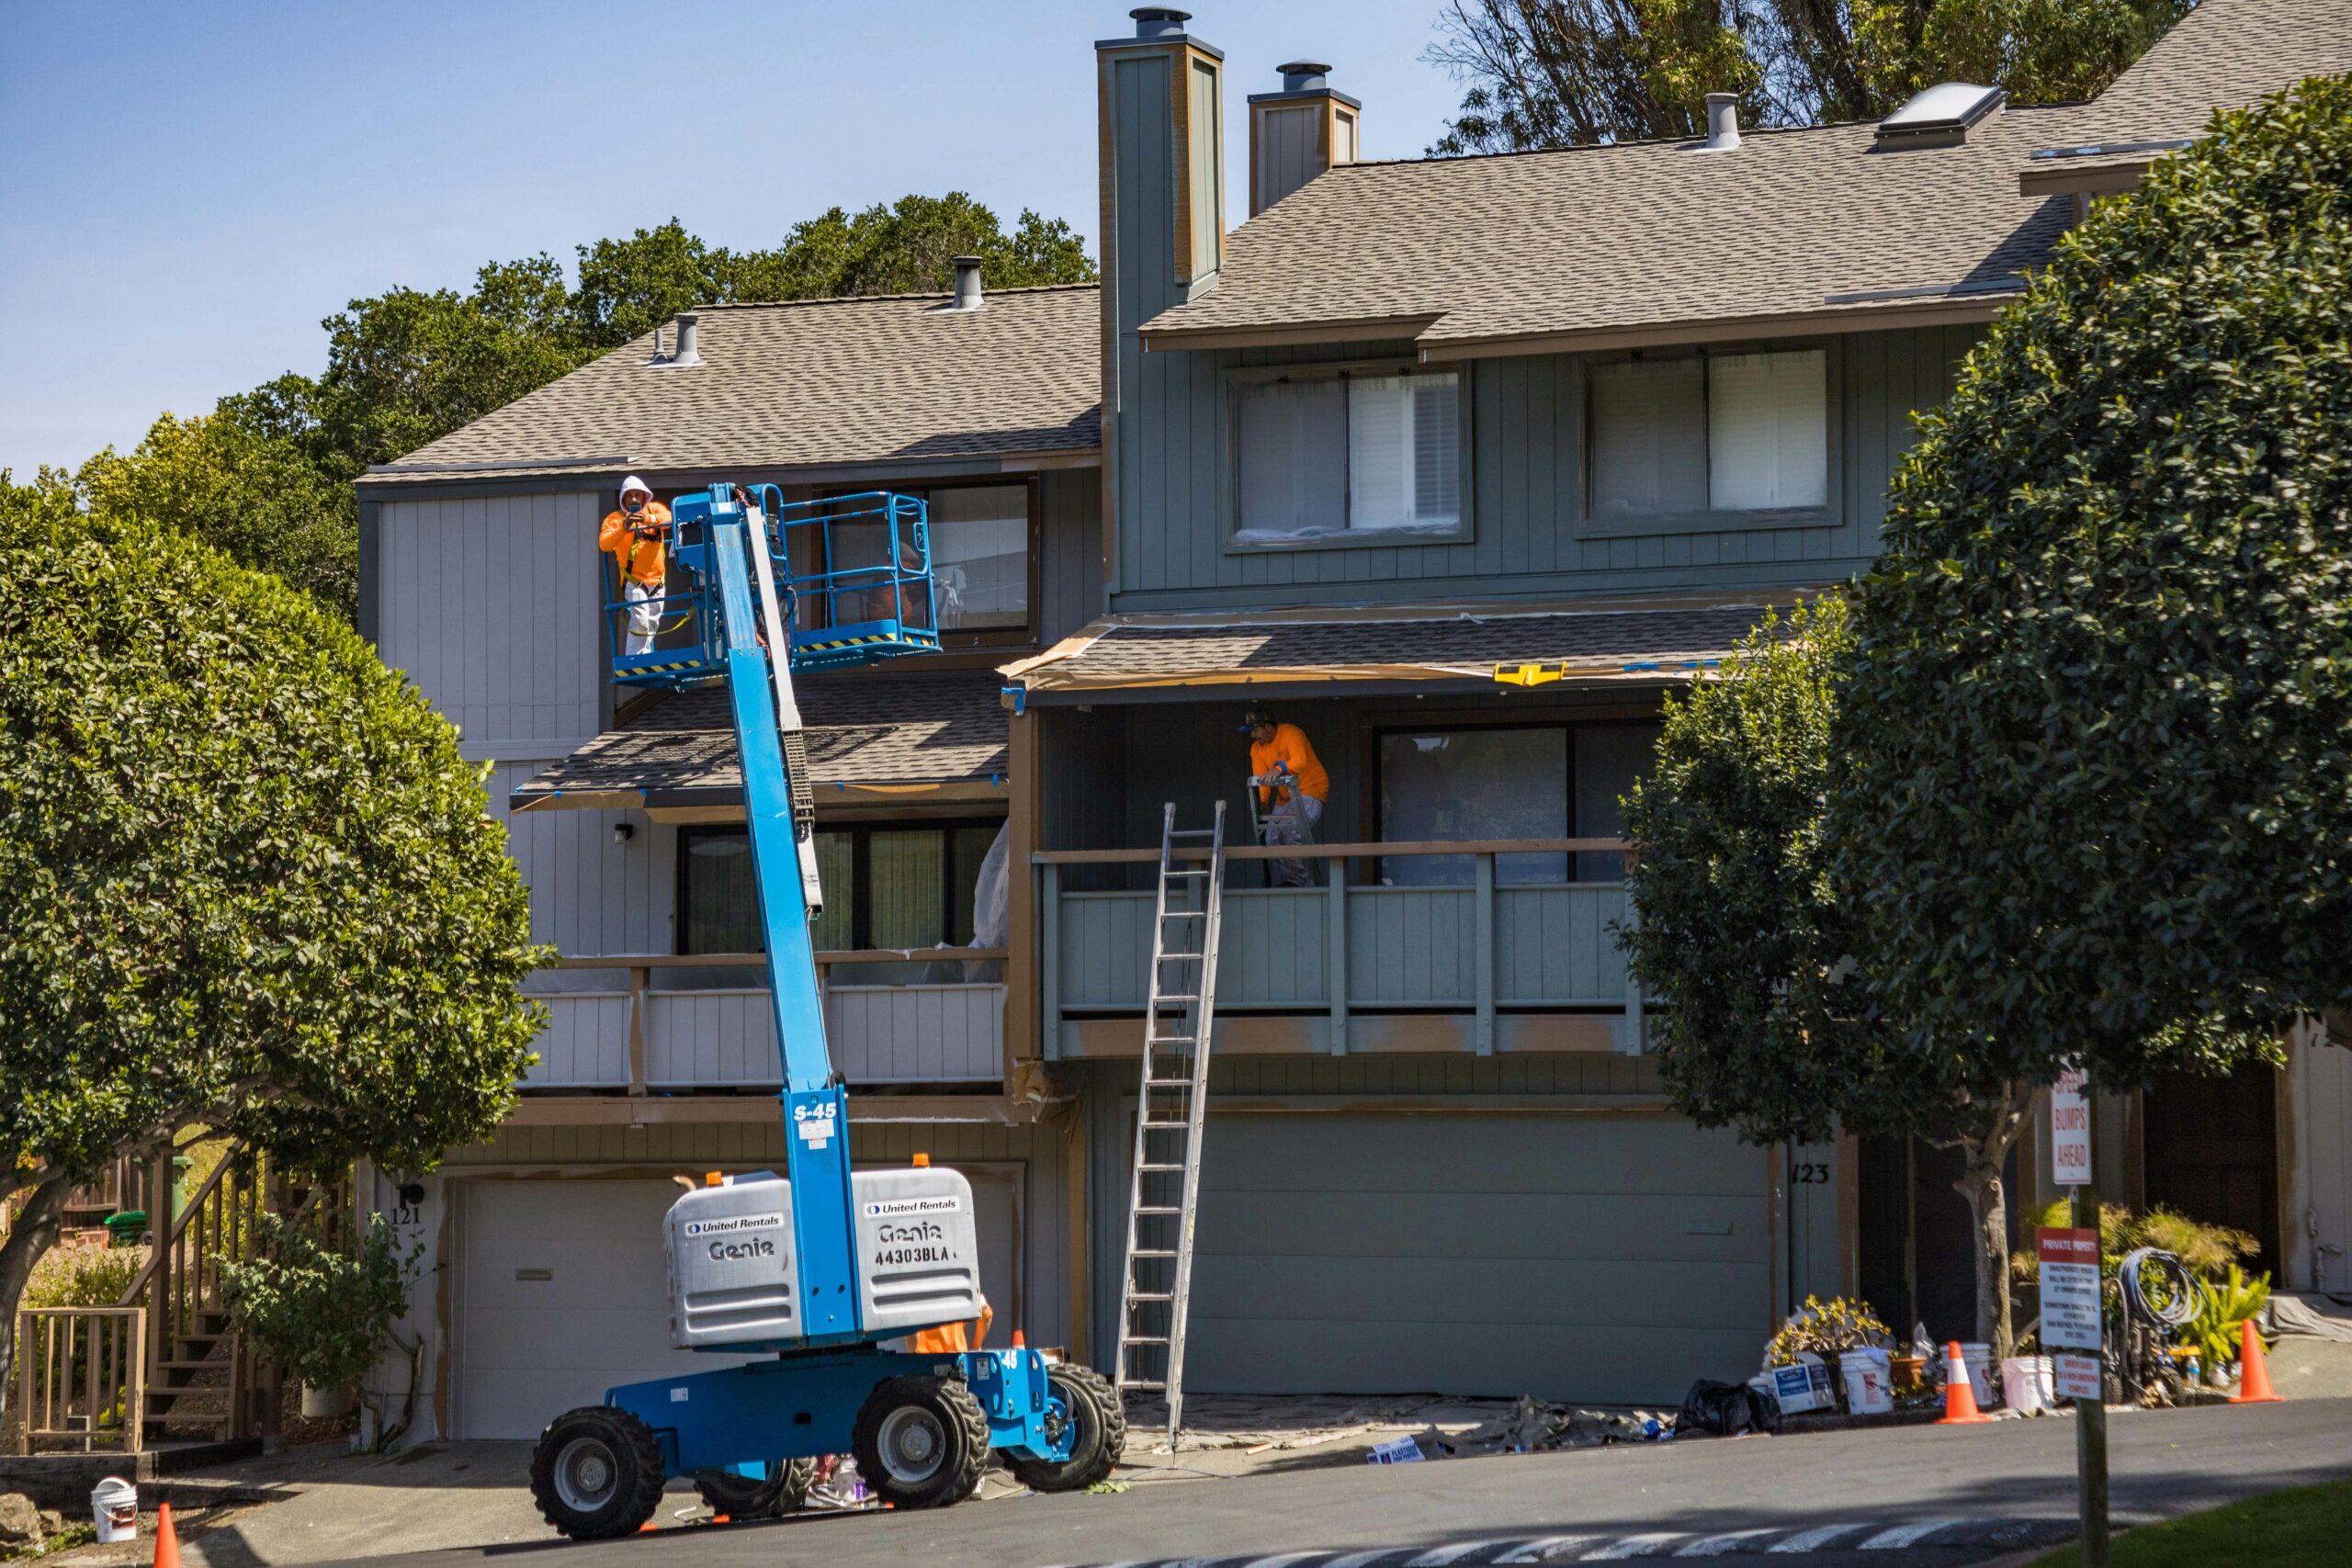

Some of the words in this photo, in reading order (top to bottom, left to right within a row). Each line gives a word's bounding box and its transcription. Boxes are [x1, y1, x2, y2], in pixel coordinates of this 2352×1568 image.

[794, 1102, 837, 1121] S-45
[2056, 1107, 2086, 1131] BUMPS
[2058, 1145, 2086, 1168] AHEAD
[1792, 1163, 1829, 1184] 123
[390, 1207, 423, 1225] 121
[883, 1202, 917, 1213] United
[920, 1200, 956, 1211] Rentals
[703, 1220, 738, 1233] United
[741, 1217, 779, 1229] Rentals
[878, 1221, 943, 1244] Genie
[708, 1237, 775, 1262] Genie
[2042, 1239, 2072, 1251] PRIVATE
[875, 1247, 949, 1266] 44303BLA
[996, 1350, 1018, 1370] -45
